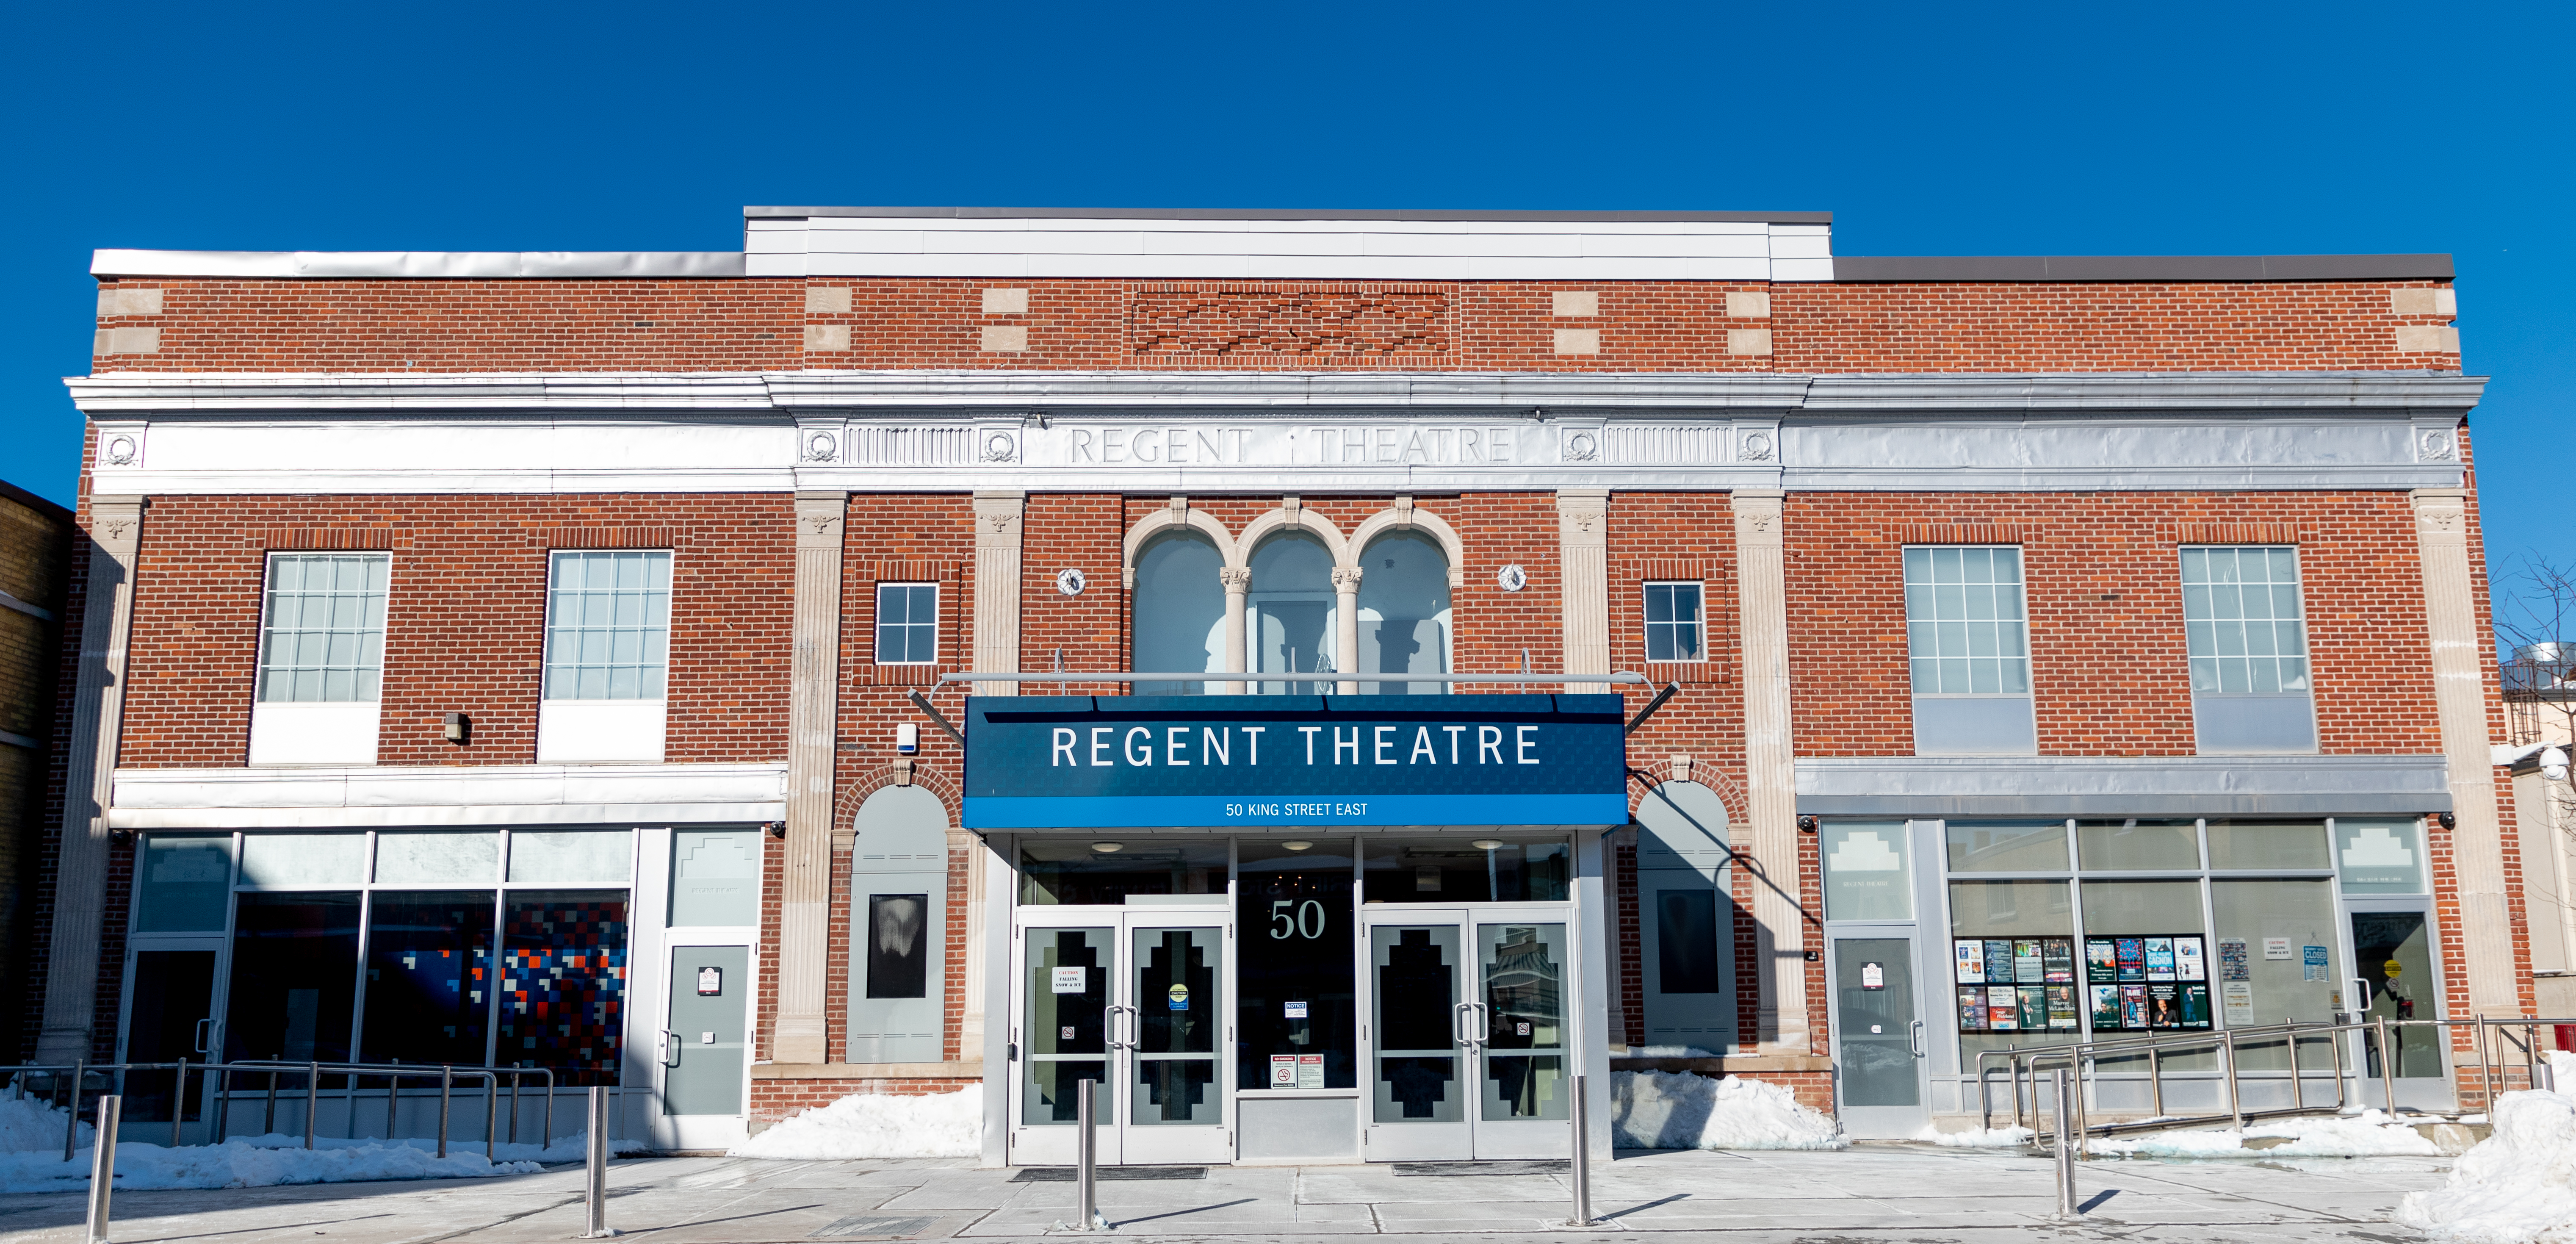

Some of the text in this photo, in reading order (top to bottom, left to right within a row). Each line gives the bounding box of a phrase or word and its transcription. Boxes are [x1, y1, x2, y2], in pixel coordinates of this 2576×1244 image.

[1072, 428, 1510, 463] REGENT THEATRE
[1053, 726, 1540, 767] REGENT THEATRE
[1226, 803, 1368, 816] 50 KING STREET EAST
[1270, 900, 1325, 939] 50
[2147, 956, 2172, 965] GAGNON
[2305, 951, 2327, 959] CLOSED
